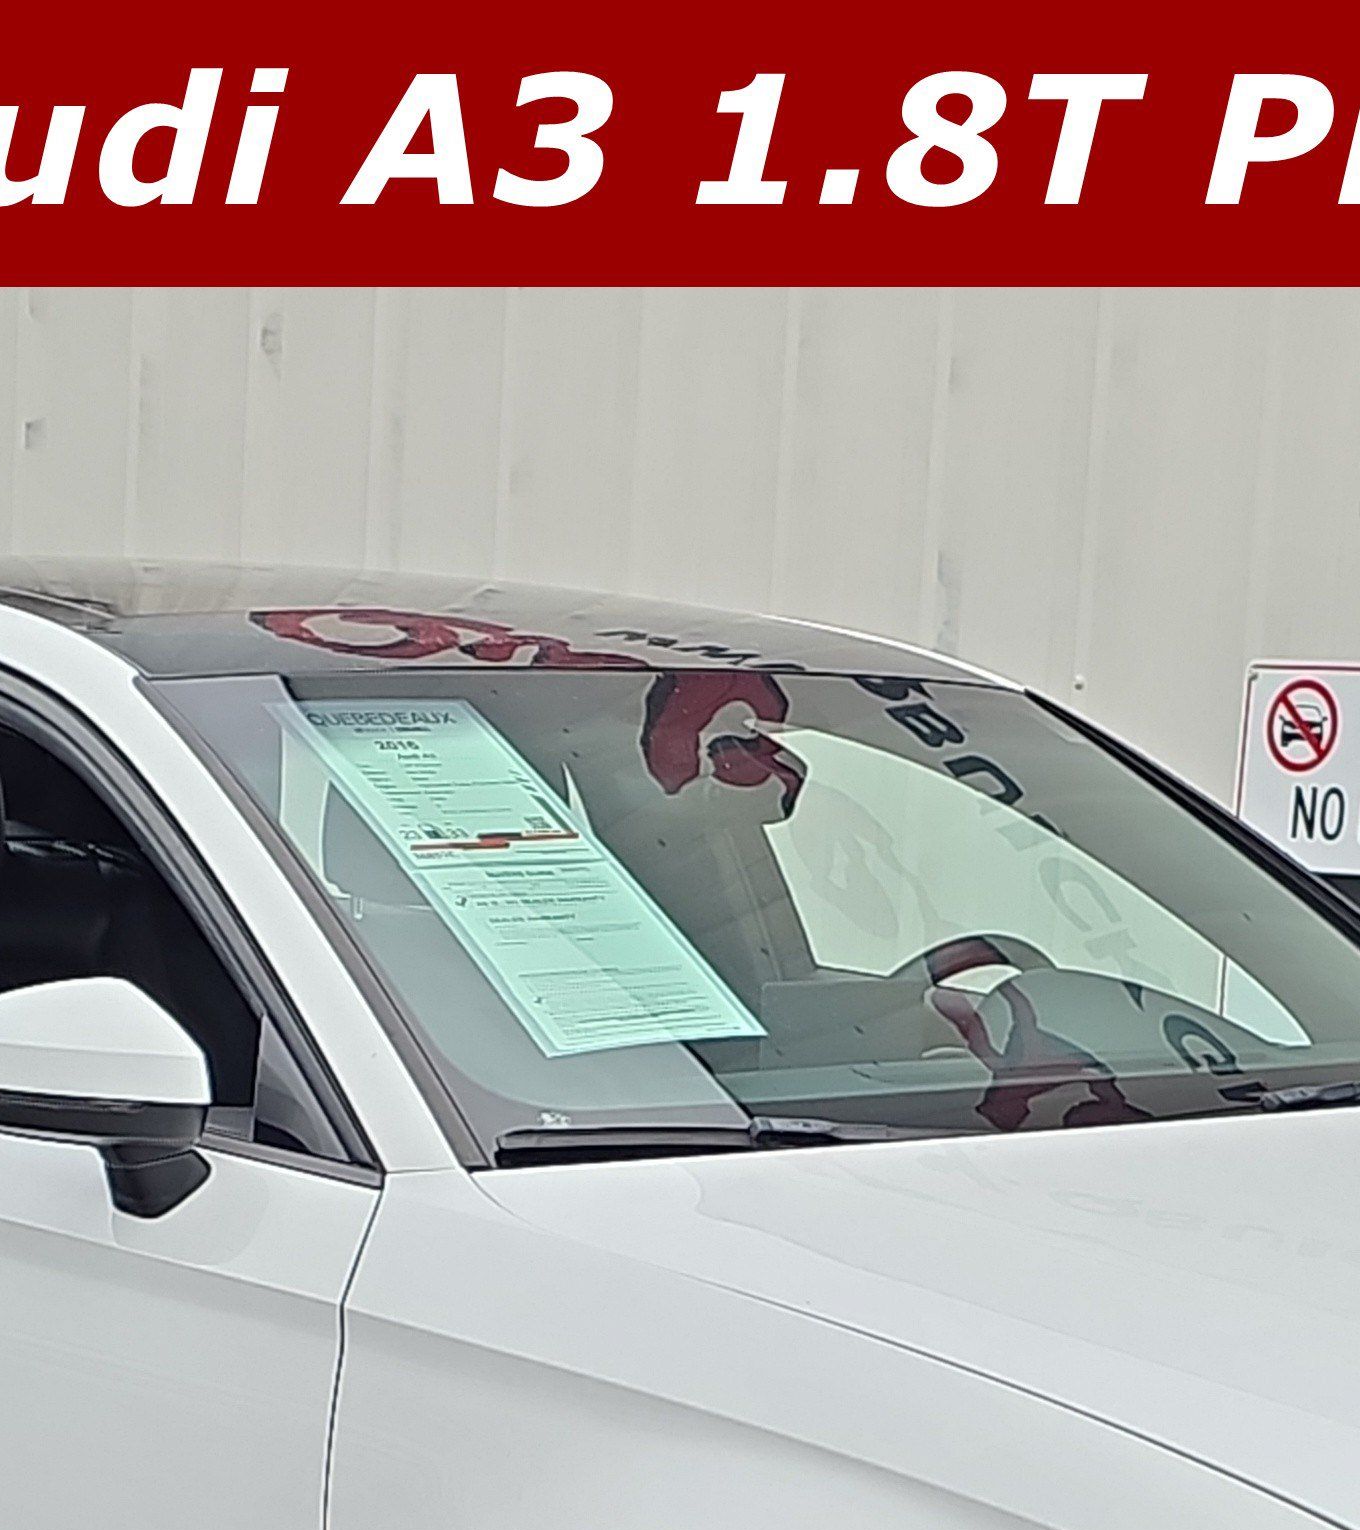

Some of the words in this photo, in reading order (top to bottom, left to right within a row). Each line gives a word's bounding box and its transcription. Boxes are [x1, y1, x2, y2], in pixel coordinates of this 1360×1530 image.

[307, 711, 458, 728] QUEBEDEAUX
[374, 739, 421, 751] 2016
[1290, 786, 1346, 842] NO
